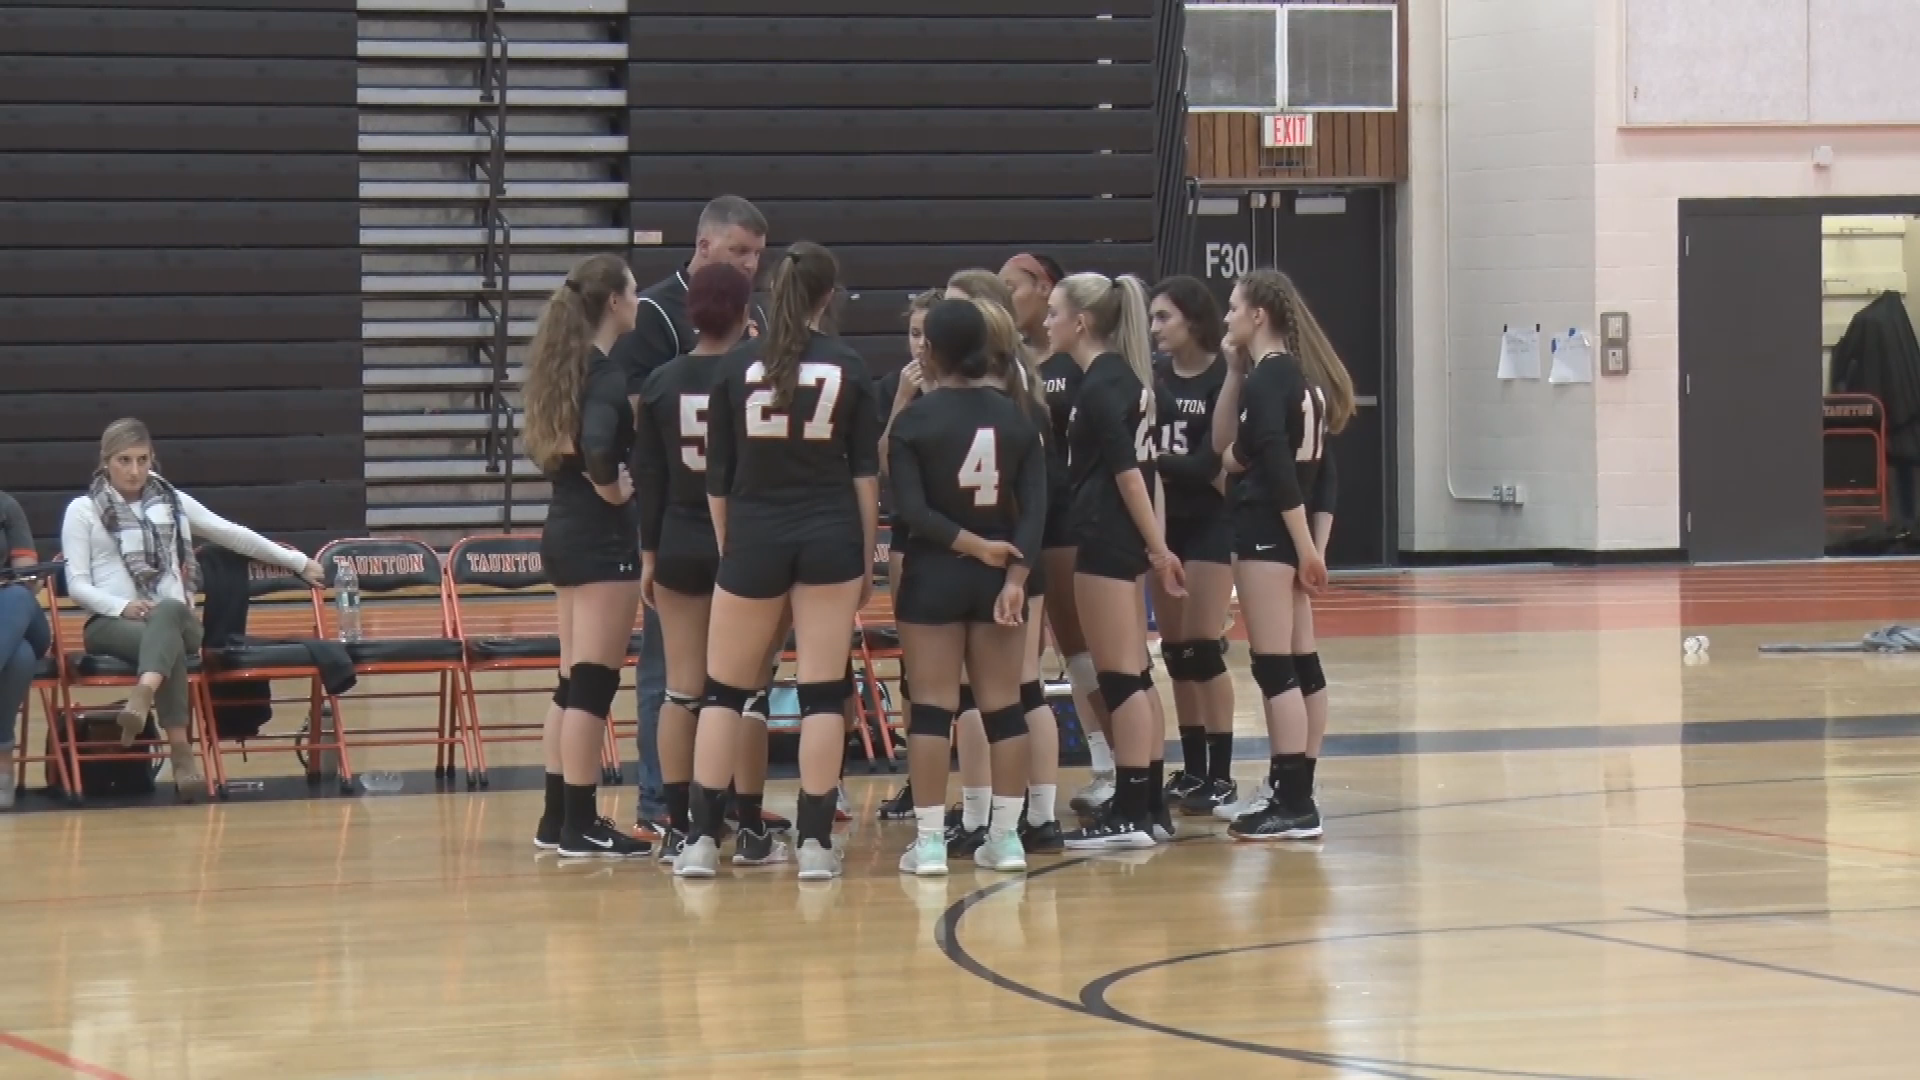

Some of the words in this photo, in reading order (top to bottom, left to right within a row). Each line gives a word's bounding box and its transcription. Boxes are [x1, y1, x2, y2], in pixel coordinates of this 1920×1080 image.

[1274, 117, 1306, 145] EXIT
[1205, 242, 1249, 279] F30
[745, 360, 842, 441] 27
[679, 393, 711, 472] 5
[1160, 420, 1189, 455] 15
[957, 427, 1000, 506] 4
[332, 553, 425, 576] TAUNTON
[466, 552, 544, 573] TAUNTO
